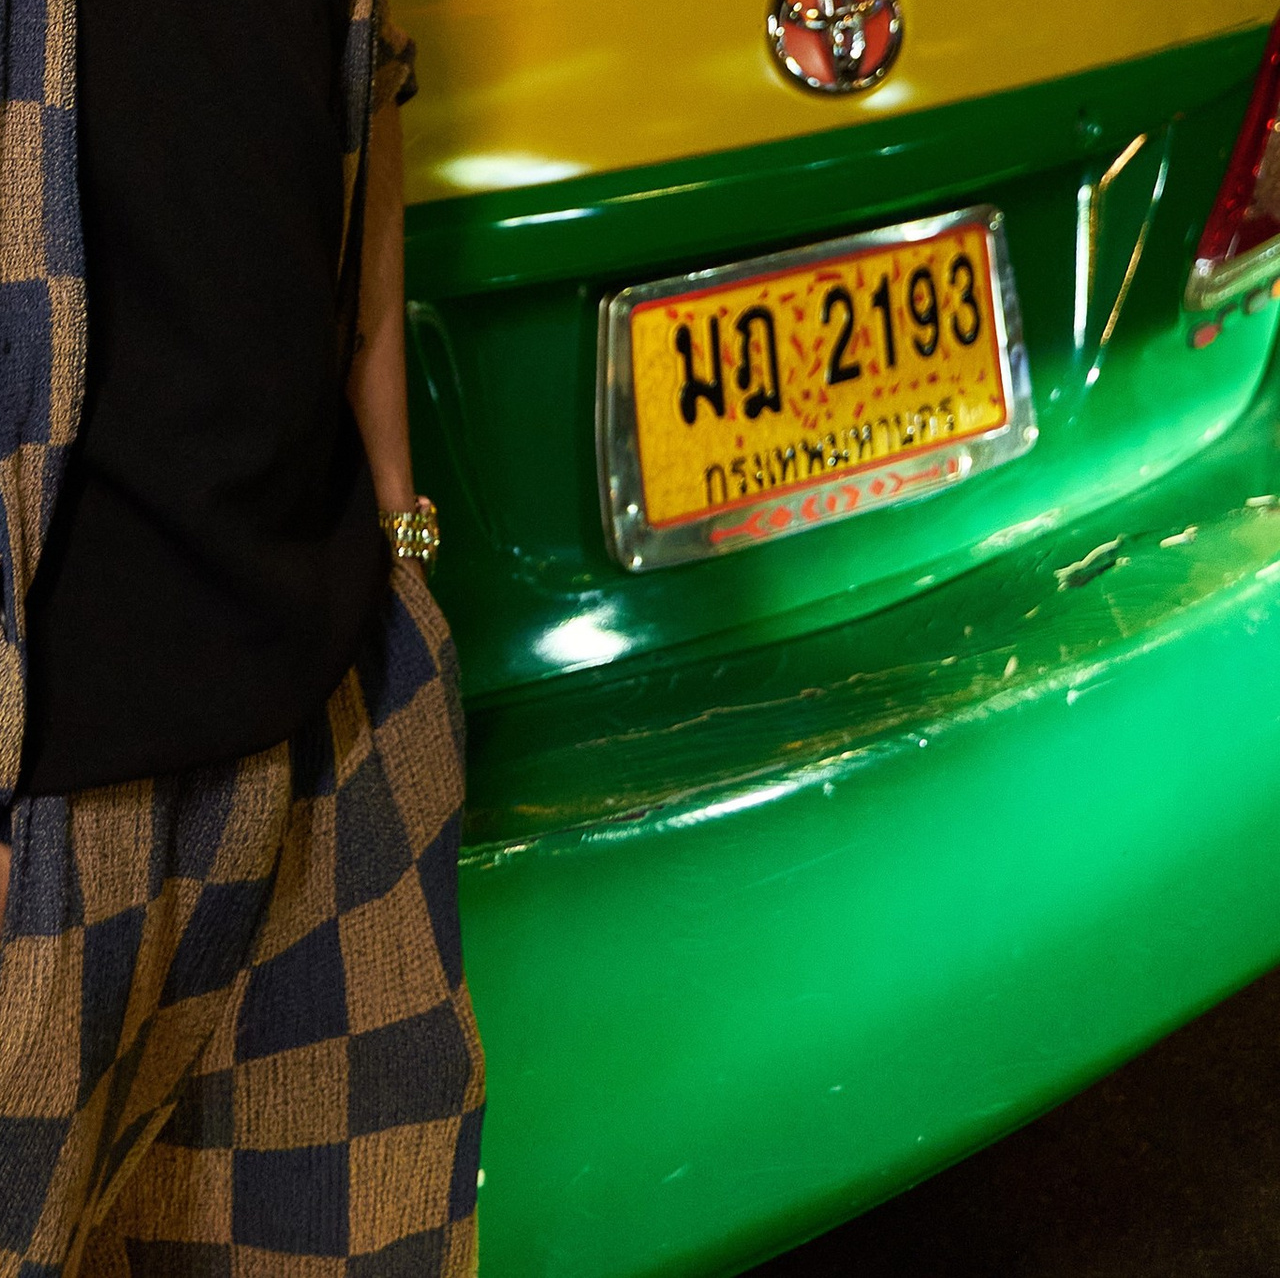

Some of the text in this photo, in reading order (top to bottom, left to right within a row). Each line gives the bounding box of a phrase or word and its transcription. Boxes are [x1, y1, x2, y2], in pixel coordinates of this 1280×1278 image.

[821, 252, 983, 387] 2193
[704, 396, 956, 507] กรงเทพมหานคร
